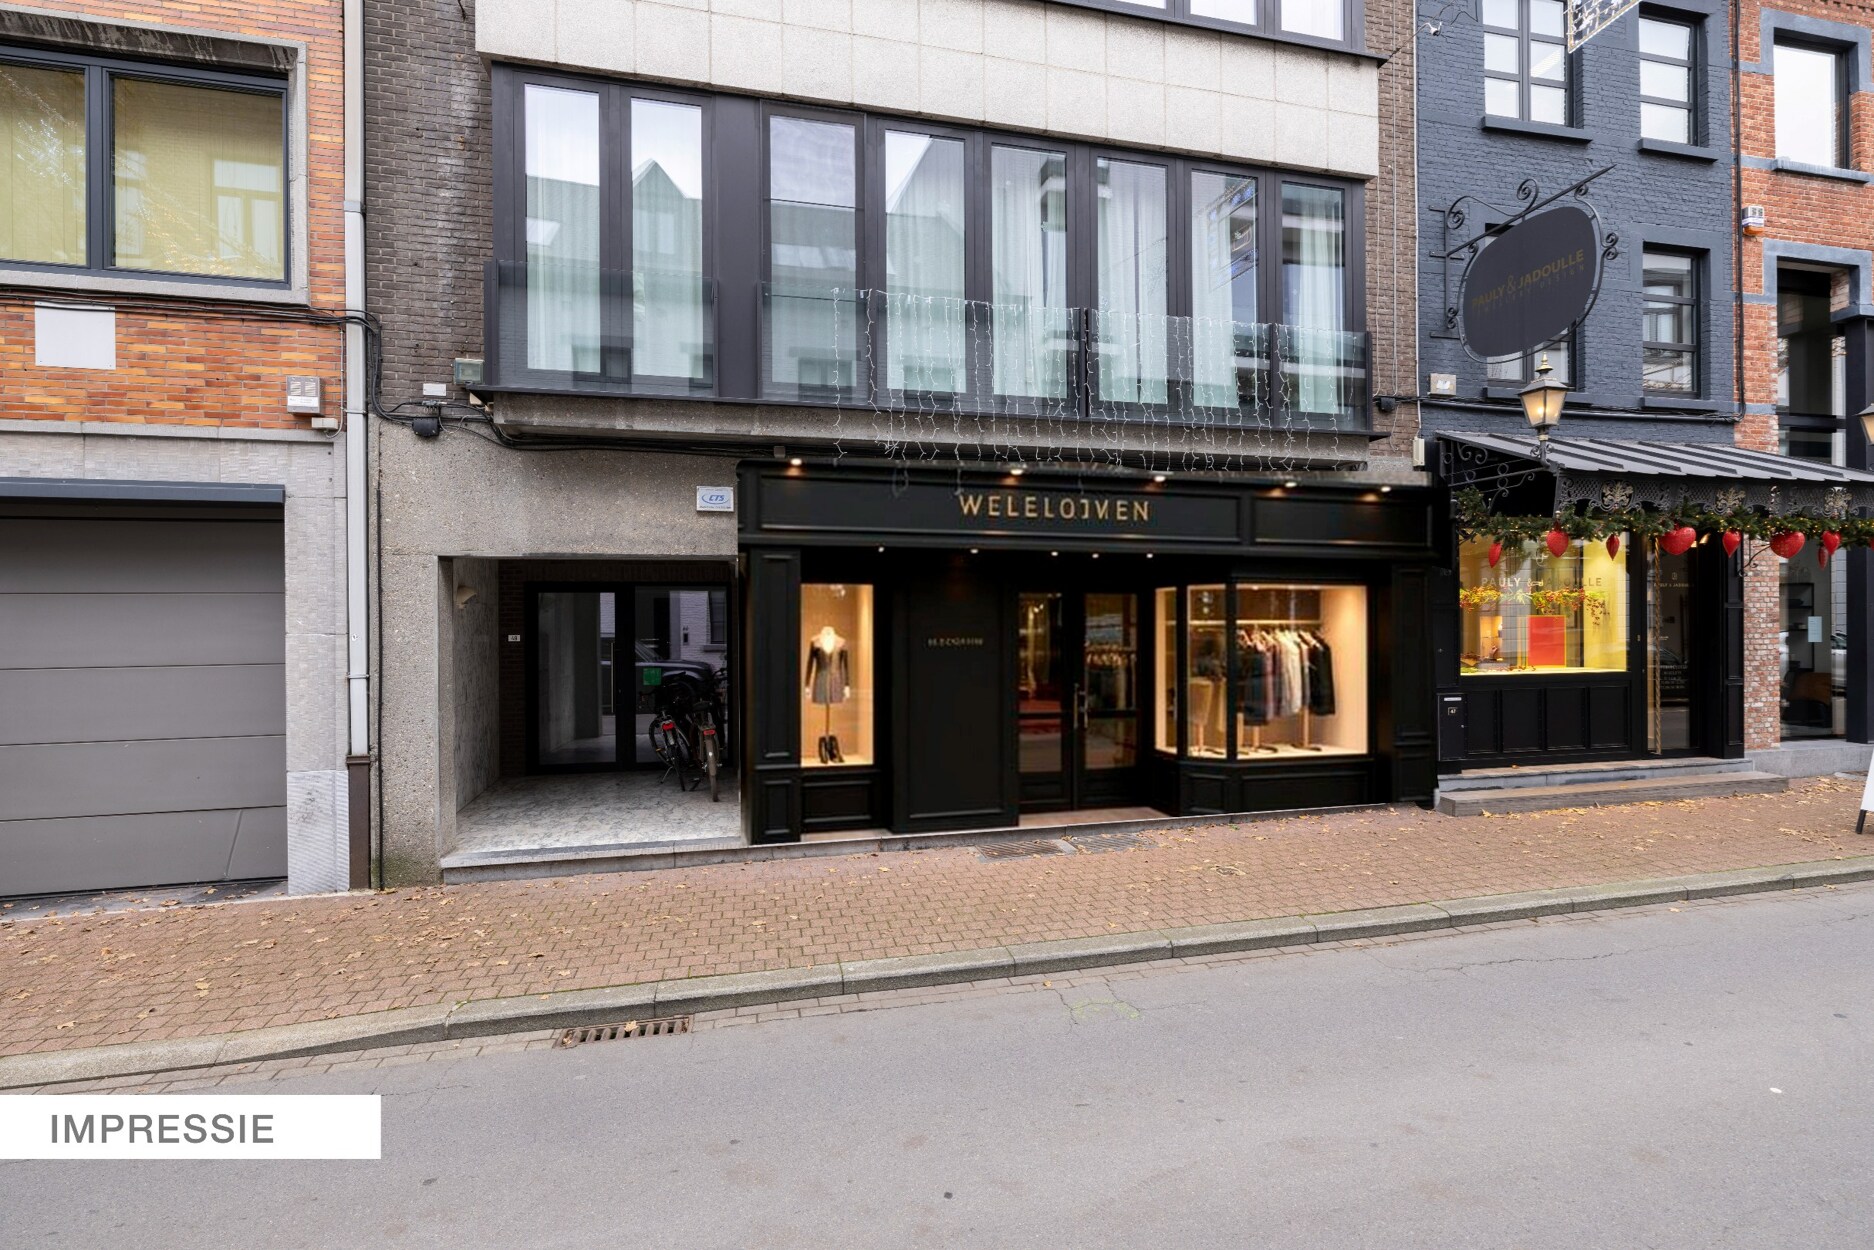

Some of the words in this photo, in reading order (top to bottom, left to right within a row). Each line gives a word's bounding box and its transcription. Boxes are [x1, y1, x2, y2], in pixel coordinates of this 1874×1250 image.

[1472, 284, 1505, 306] PAULY
[1519, 249, 1585, 289] JADOULLE
[1481, 577, 1521, 587] PAULY
